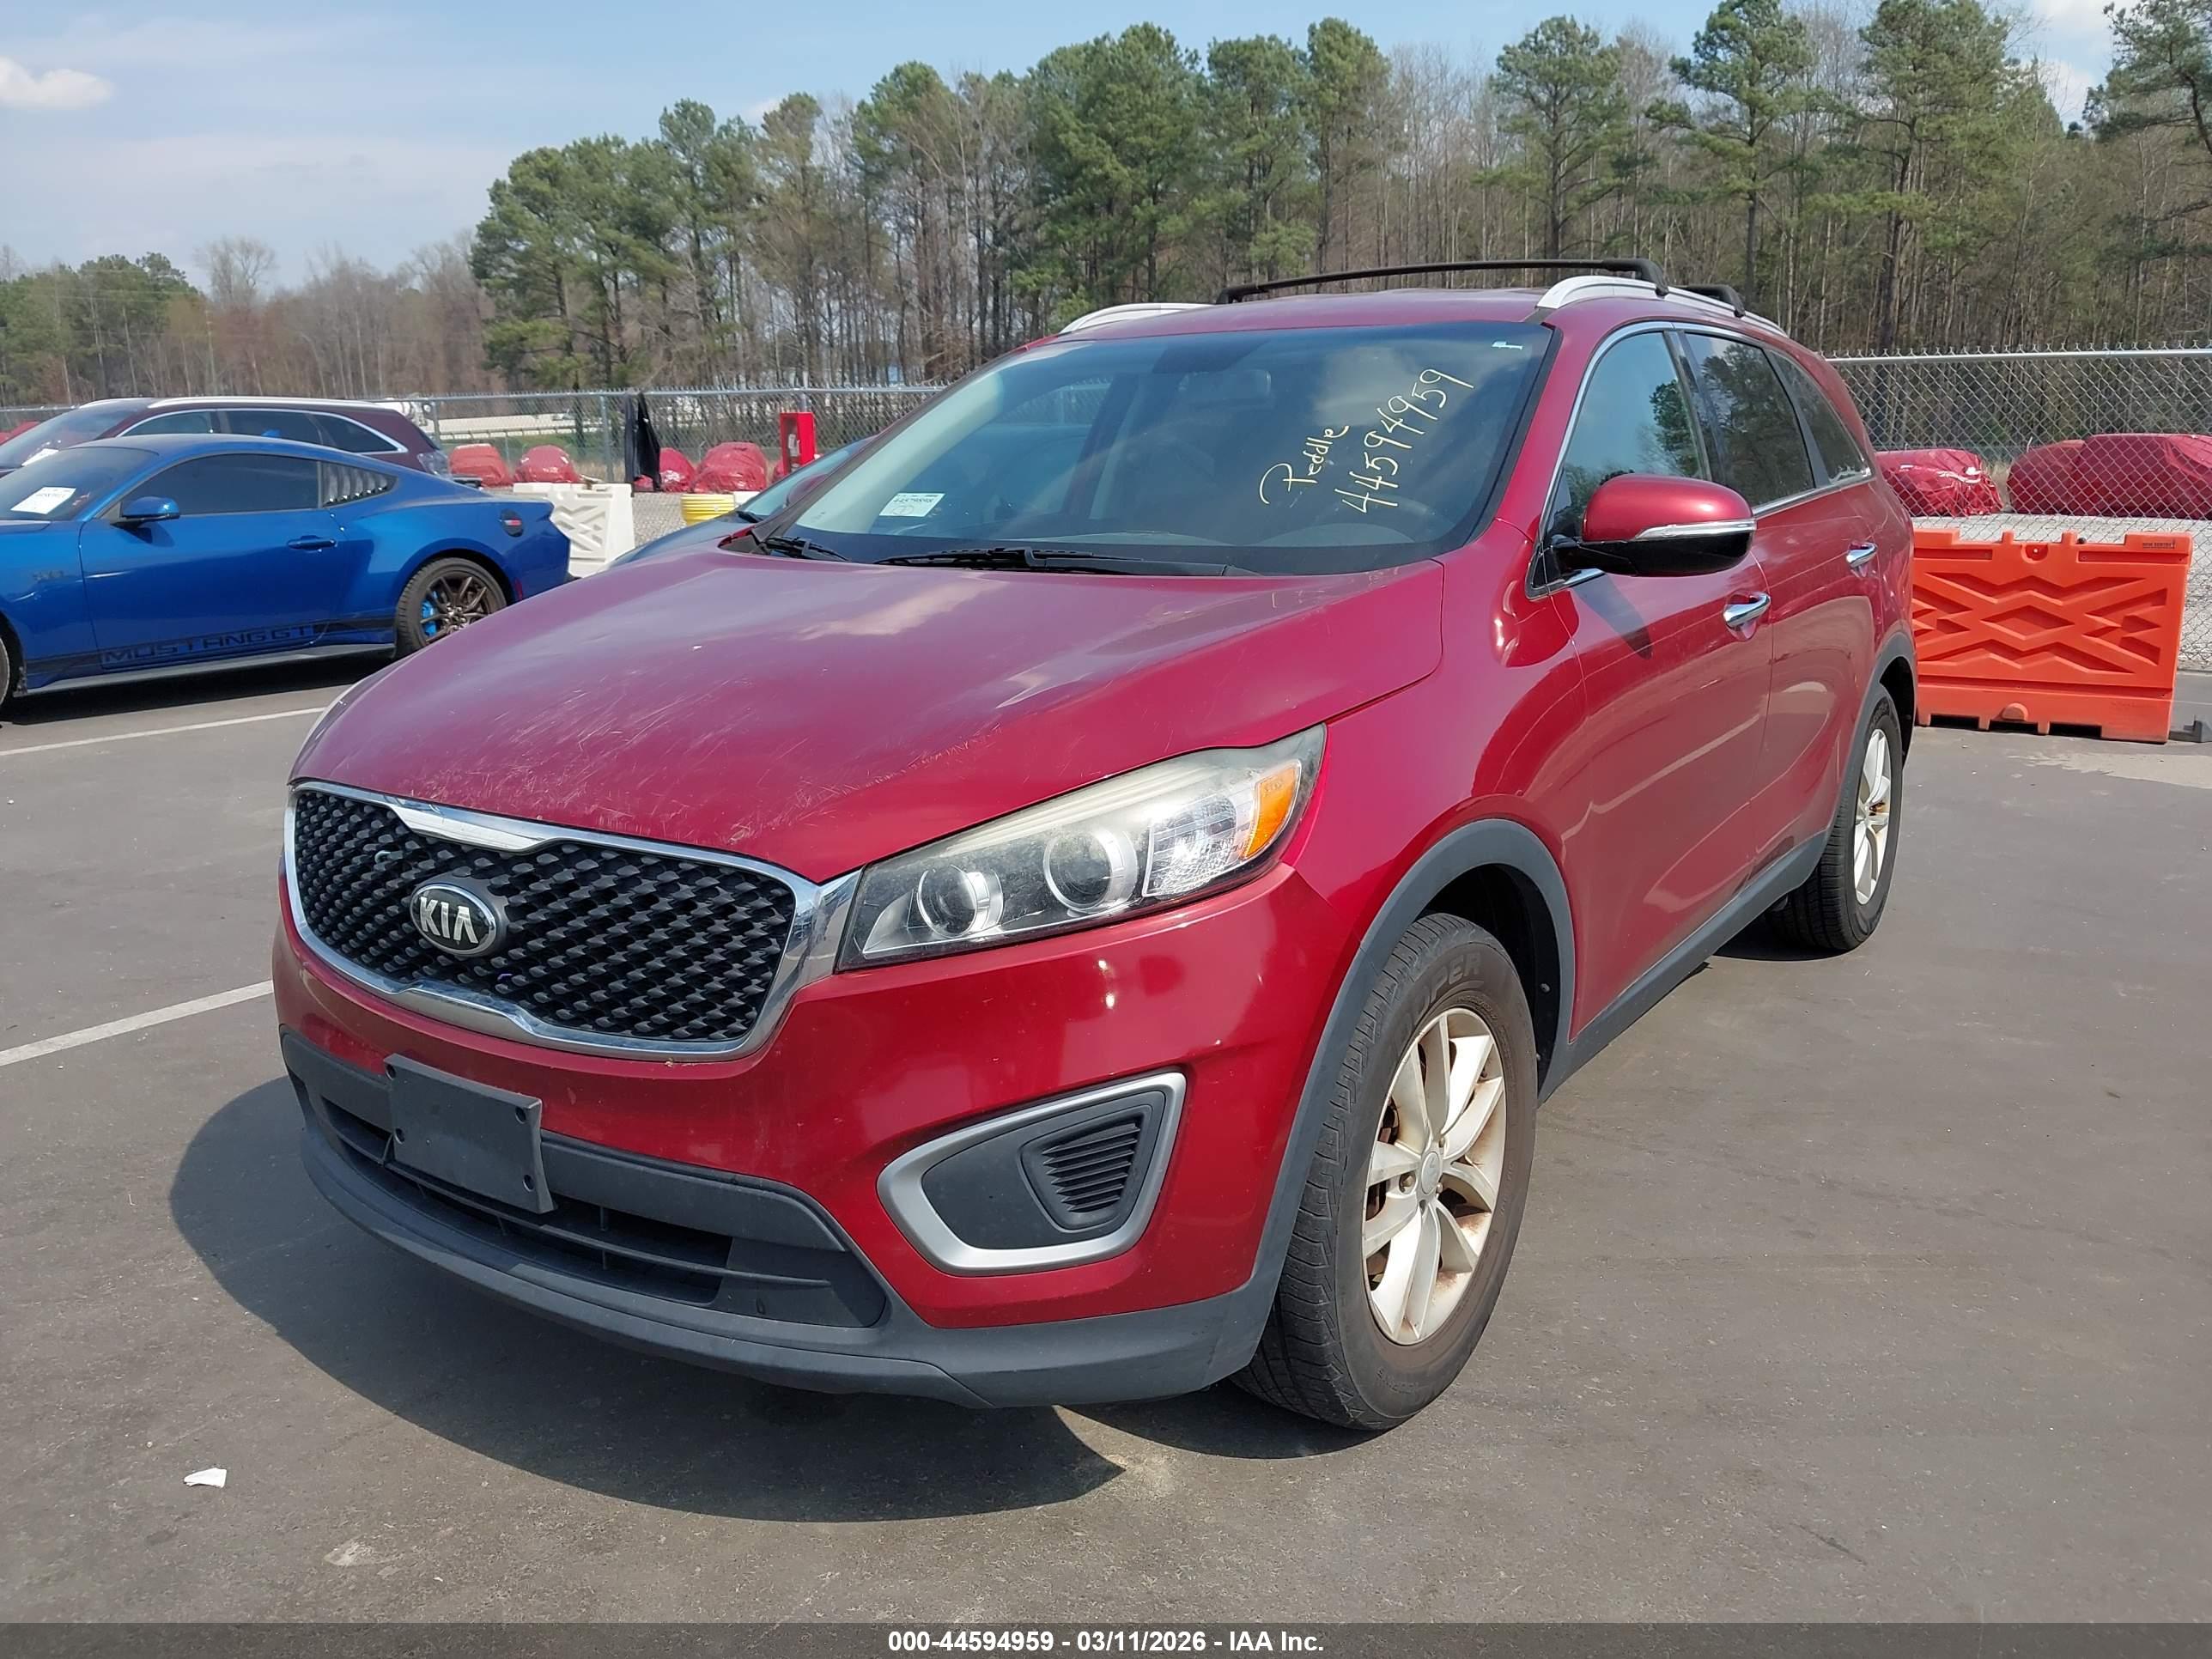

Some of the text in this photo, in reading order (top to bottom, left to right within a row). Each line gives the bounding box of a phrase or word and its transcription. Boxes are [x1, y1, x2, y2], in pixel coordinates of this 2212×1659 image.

[1334, 368, 1475, 514] 44594959
[105, 625, 311, 661] MUSTANG GT
[419, 896, 479, 945] KIA
